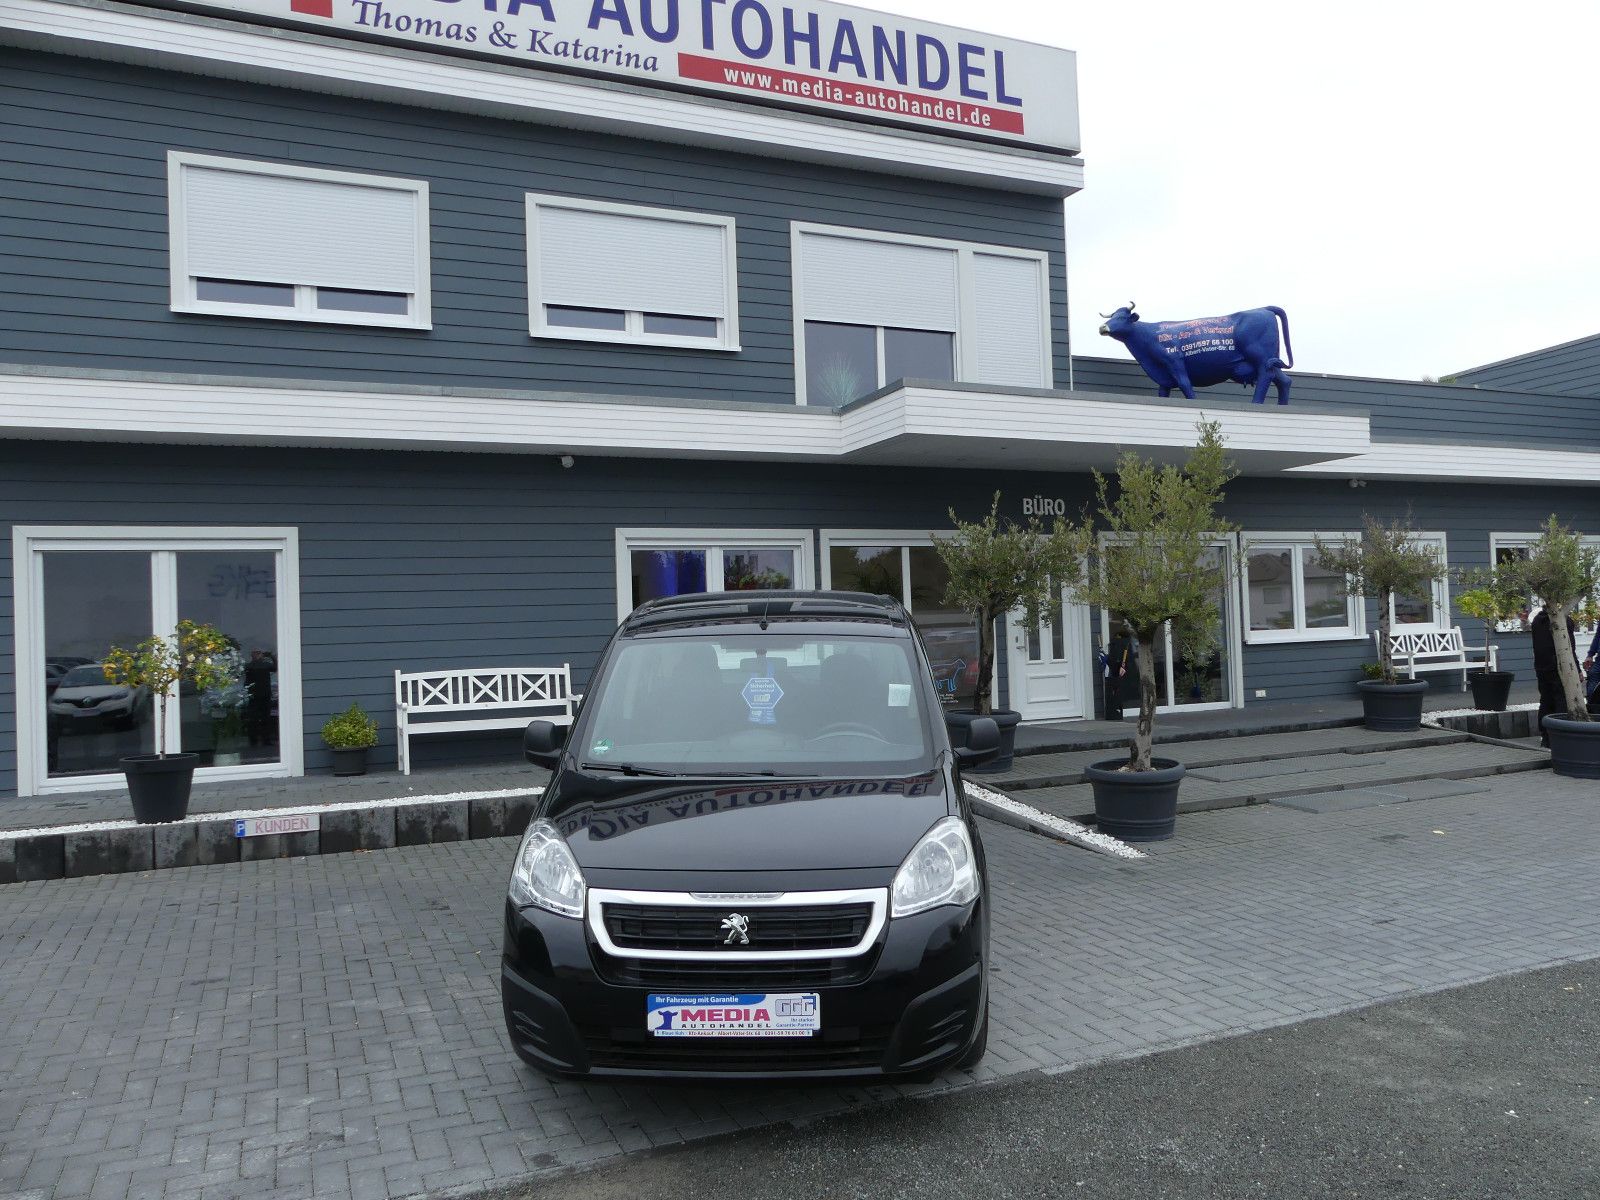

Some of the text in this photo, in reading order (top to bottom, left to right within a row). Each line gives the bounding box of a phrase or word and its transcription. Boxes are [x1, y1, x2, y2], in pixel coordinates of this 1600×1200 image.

[351, 1, 477, 43] Thomas
[488, 20, 518, 49] &
[527, 28, 659, 72] Katarina
[587, 0, 1023, 108] AUTOHANDEL
[723, 67, 992, 127] www.media-autohandel.de
[1023, 494, 1065, 515] BÜRO
[238, 817, 309, 834] P KUNDEN
[666, 996, 697, 1005] Fahrzeug
[681, 1008, 771, 1022] MEDIA
